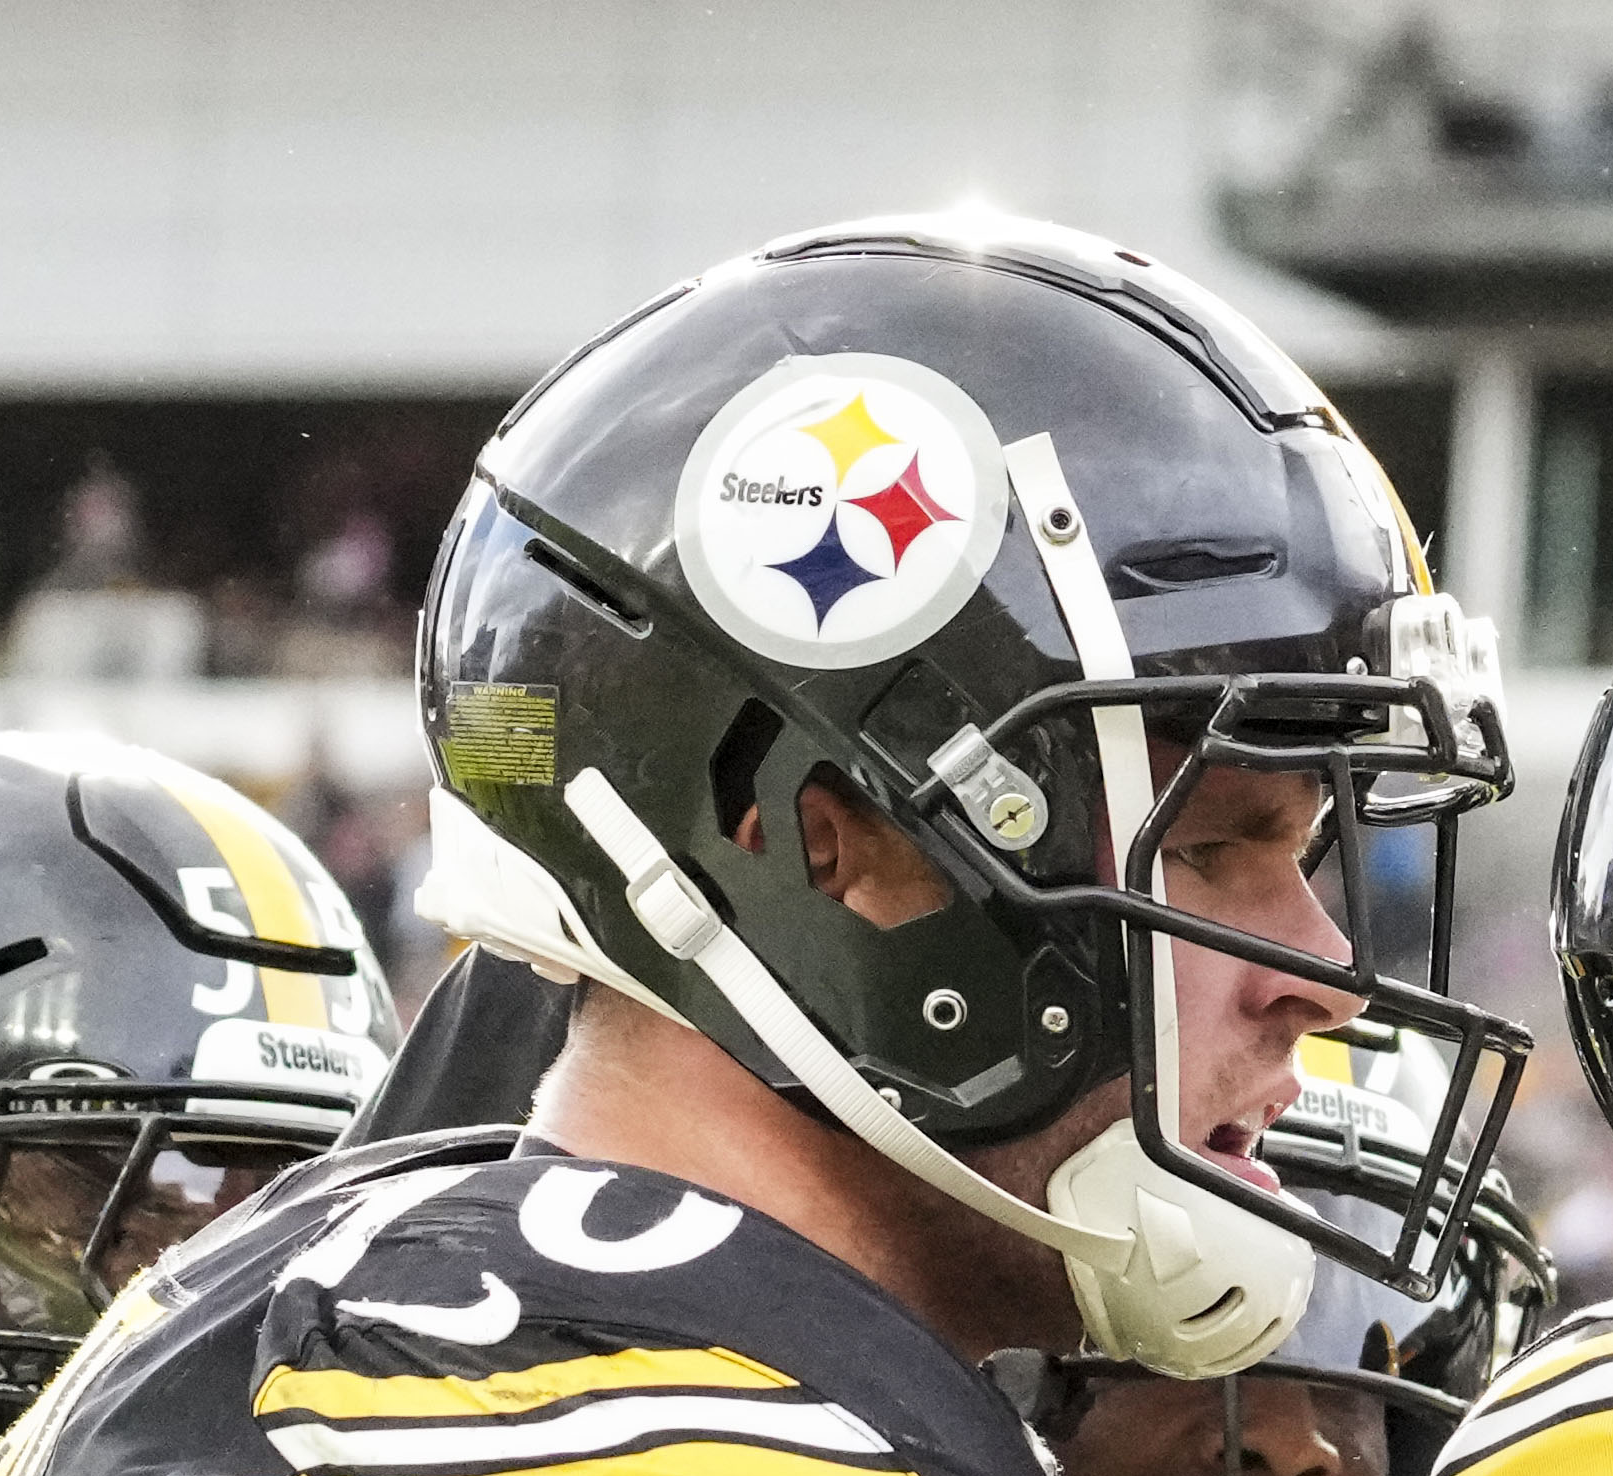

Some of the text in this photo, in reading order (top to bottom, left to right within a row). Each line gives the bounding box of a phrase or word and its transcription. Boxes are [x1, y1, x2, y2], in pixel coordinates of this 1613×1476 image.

[720, 472, 824, 507] Steelers
[472, 686, 526, 696] WARNING
[257, 1031, 364, 1079] Steelers
[1294, 1088, 1388, 1133] eelers
